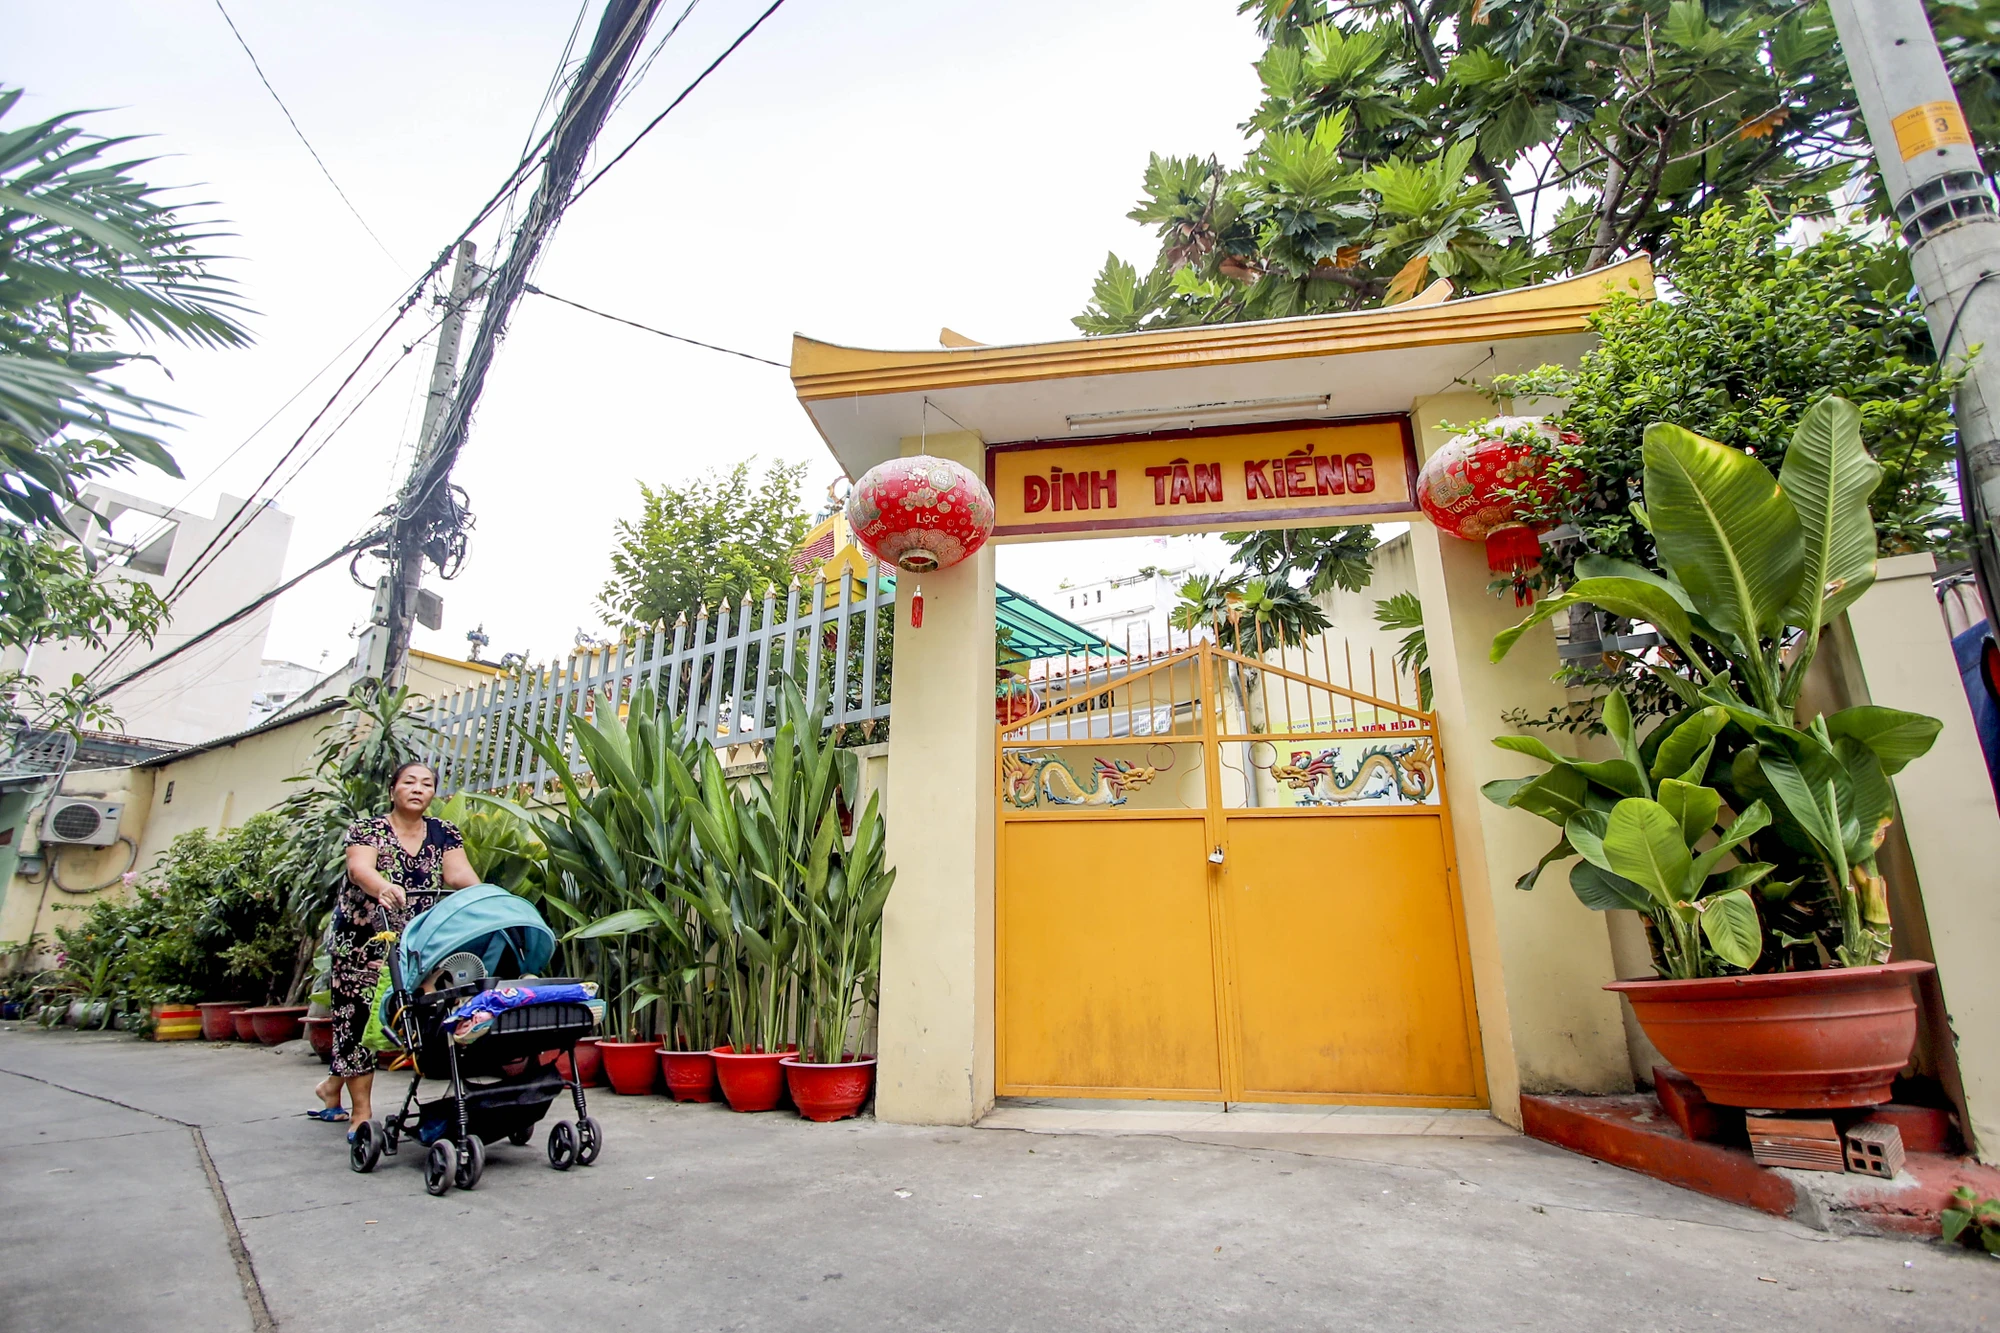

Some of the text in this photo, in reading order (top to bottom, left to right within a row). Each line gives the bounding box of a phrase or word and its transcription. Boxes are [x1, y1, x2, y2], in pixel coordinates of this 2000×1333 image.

[1935, 117, 1949, 132] 3
[1023, 466, 1117, 513] ĐÌNH
[1145, 457, 1223, 505] TÂN
